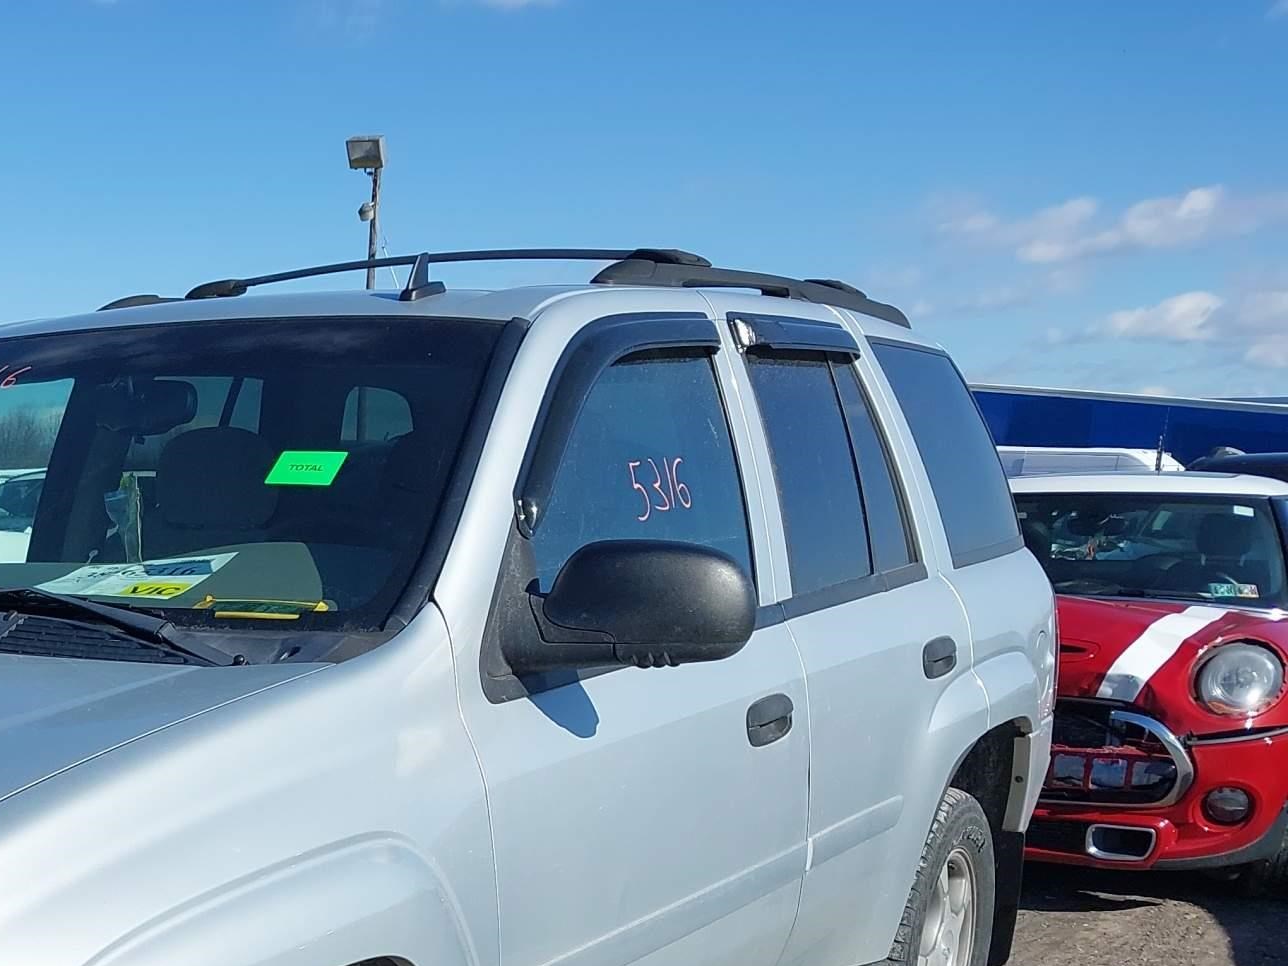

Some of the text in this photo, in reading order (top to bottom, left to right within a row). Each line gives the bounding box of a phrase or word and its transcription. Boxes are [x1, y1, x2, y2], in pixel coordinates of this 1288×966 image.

[288, 464, 326, 473] TOTAL
[628, 456, 692, 522] 5316
[129, 585, 181, 596] VIC
